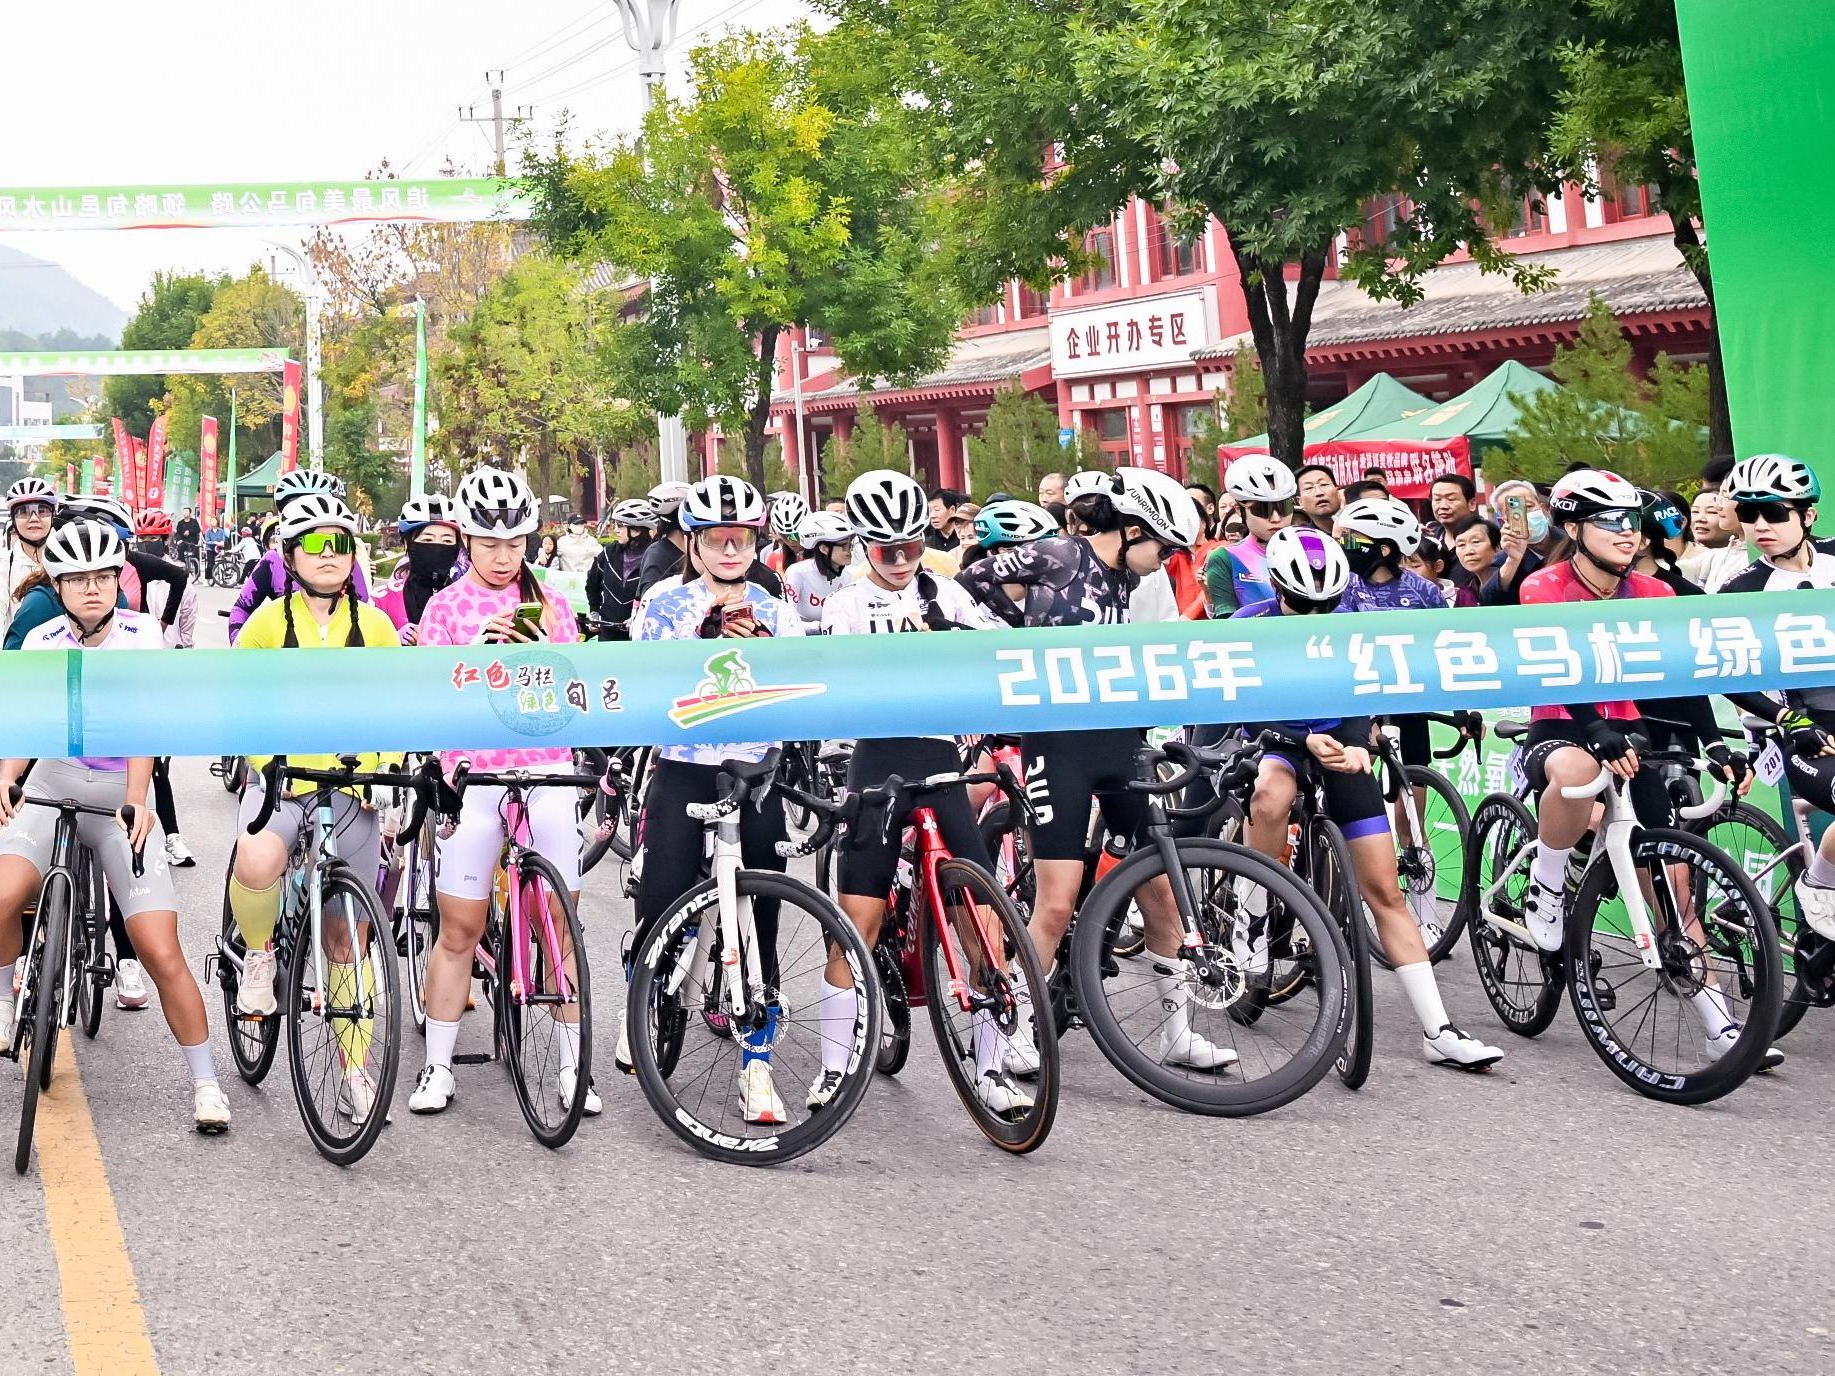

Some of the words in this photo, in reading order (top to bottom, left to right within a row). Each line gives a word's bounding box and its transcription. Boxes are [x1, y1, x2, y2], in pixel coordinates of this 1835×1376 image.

[1066, 312, 1187, 359] 企业开办专区
[1126, 487, 1170, 530] SUNRIMOON
[995, 641, 1263, 707] 2026年
[1306, 619, 1666, 697] “红色马栏
[1763, 756, 1782, 775] 201
